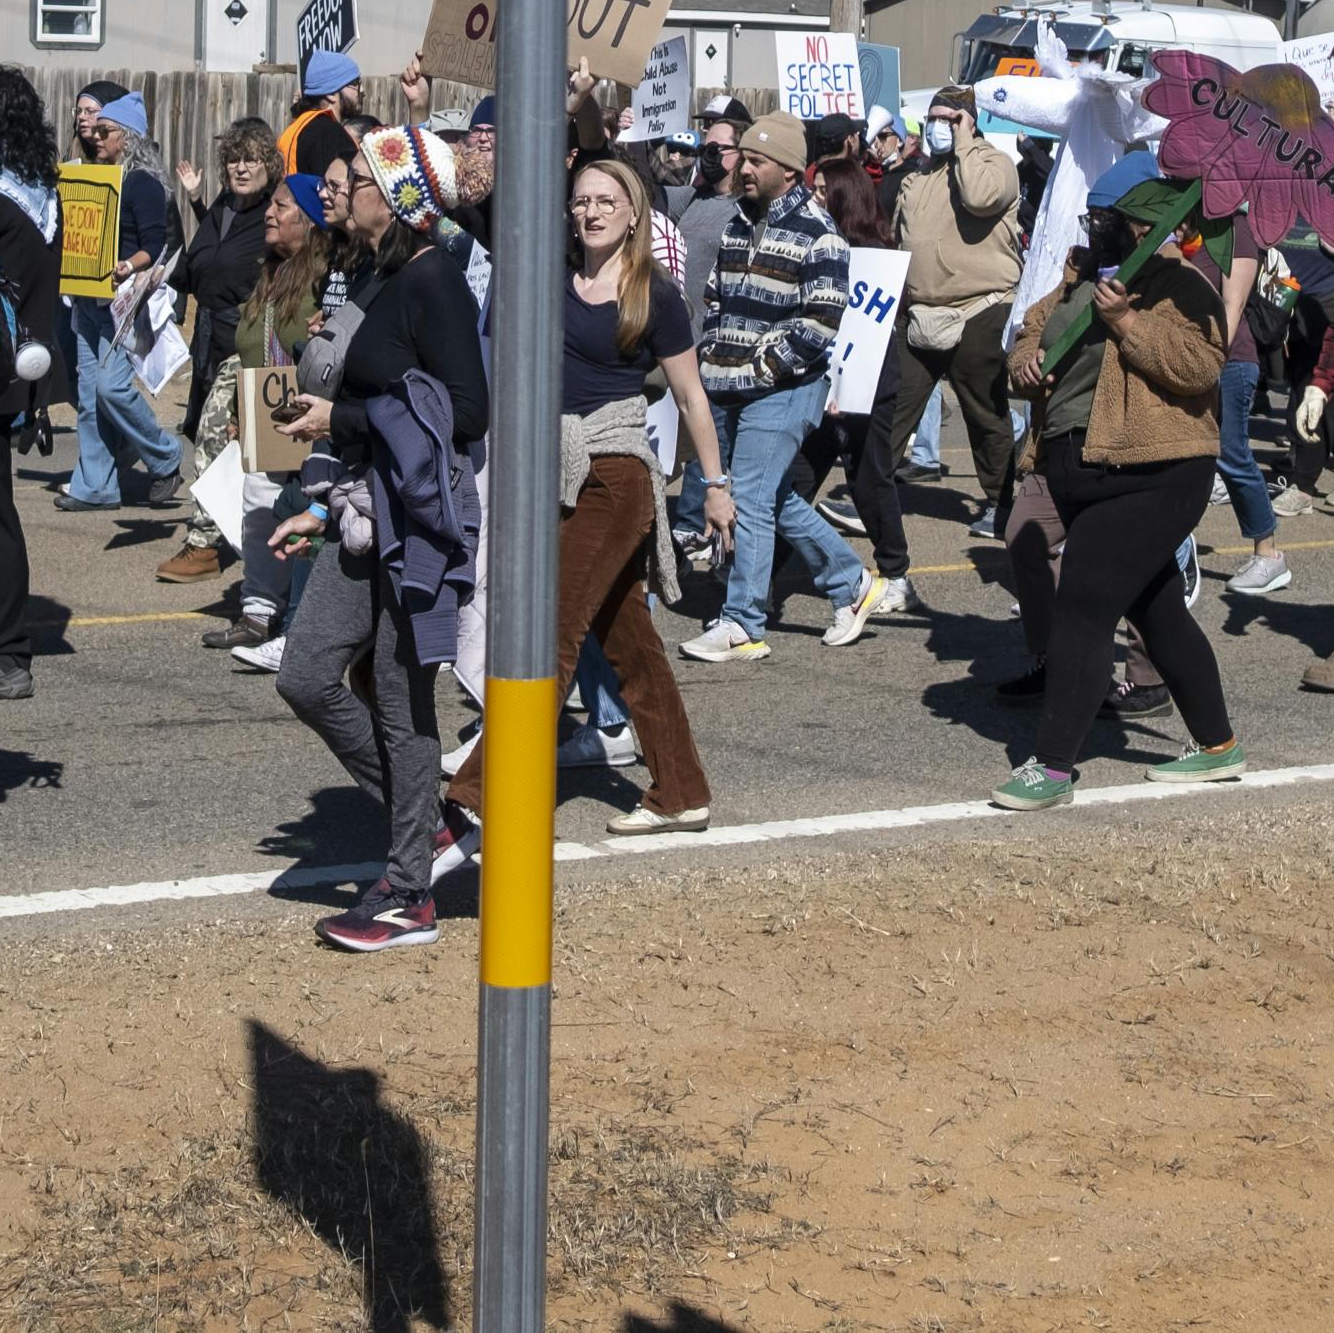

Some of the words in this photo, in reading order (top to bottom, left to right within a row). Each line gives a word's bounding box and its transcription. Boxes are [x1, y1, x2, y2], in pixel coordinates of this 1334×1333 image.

[805, 35, 829, 64] NO
[652, 81, 667, 97] Not
[786, 63, 855, 93] SECRET
[641, 99, 677, 118] Immigration
[788, 91, 860, 118] POLICE
[80, 233, 99, 256] KIDS
